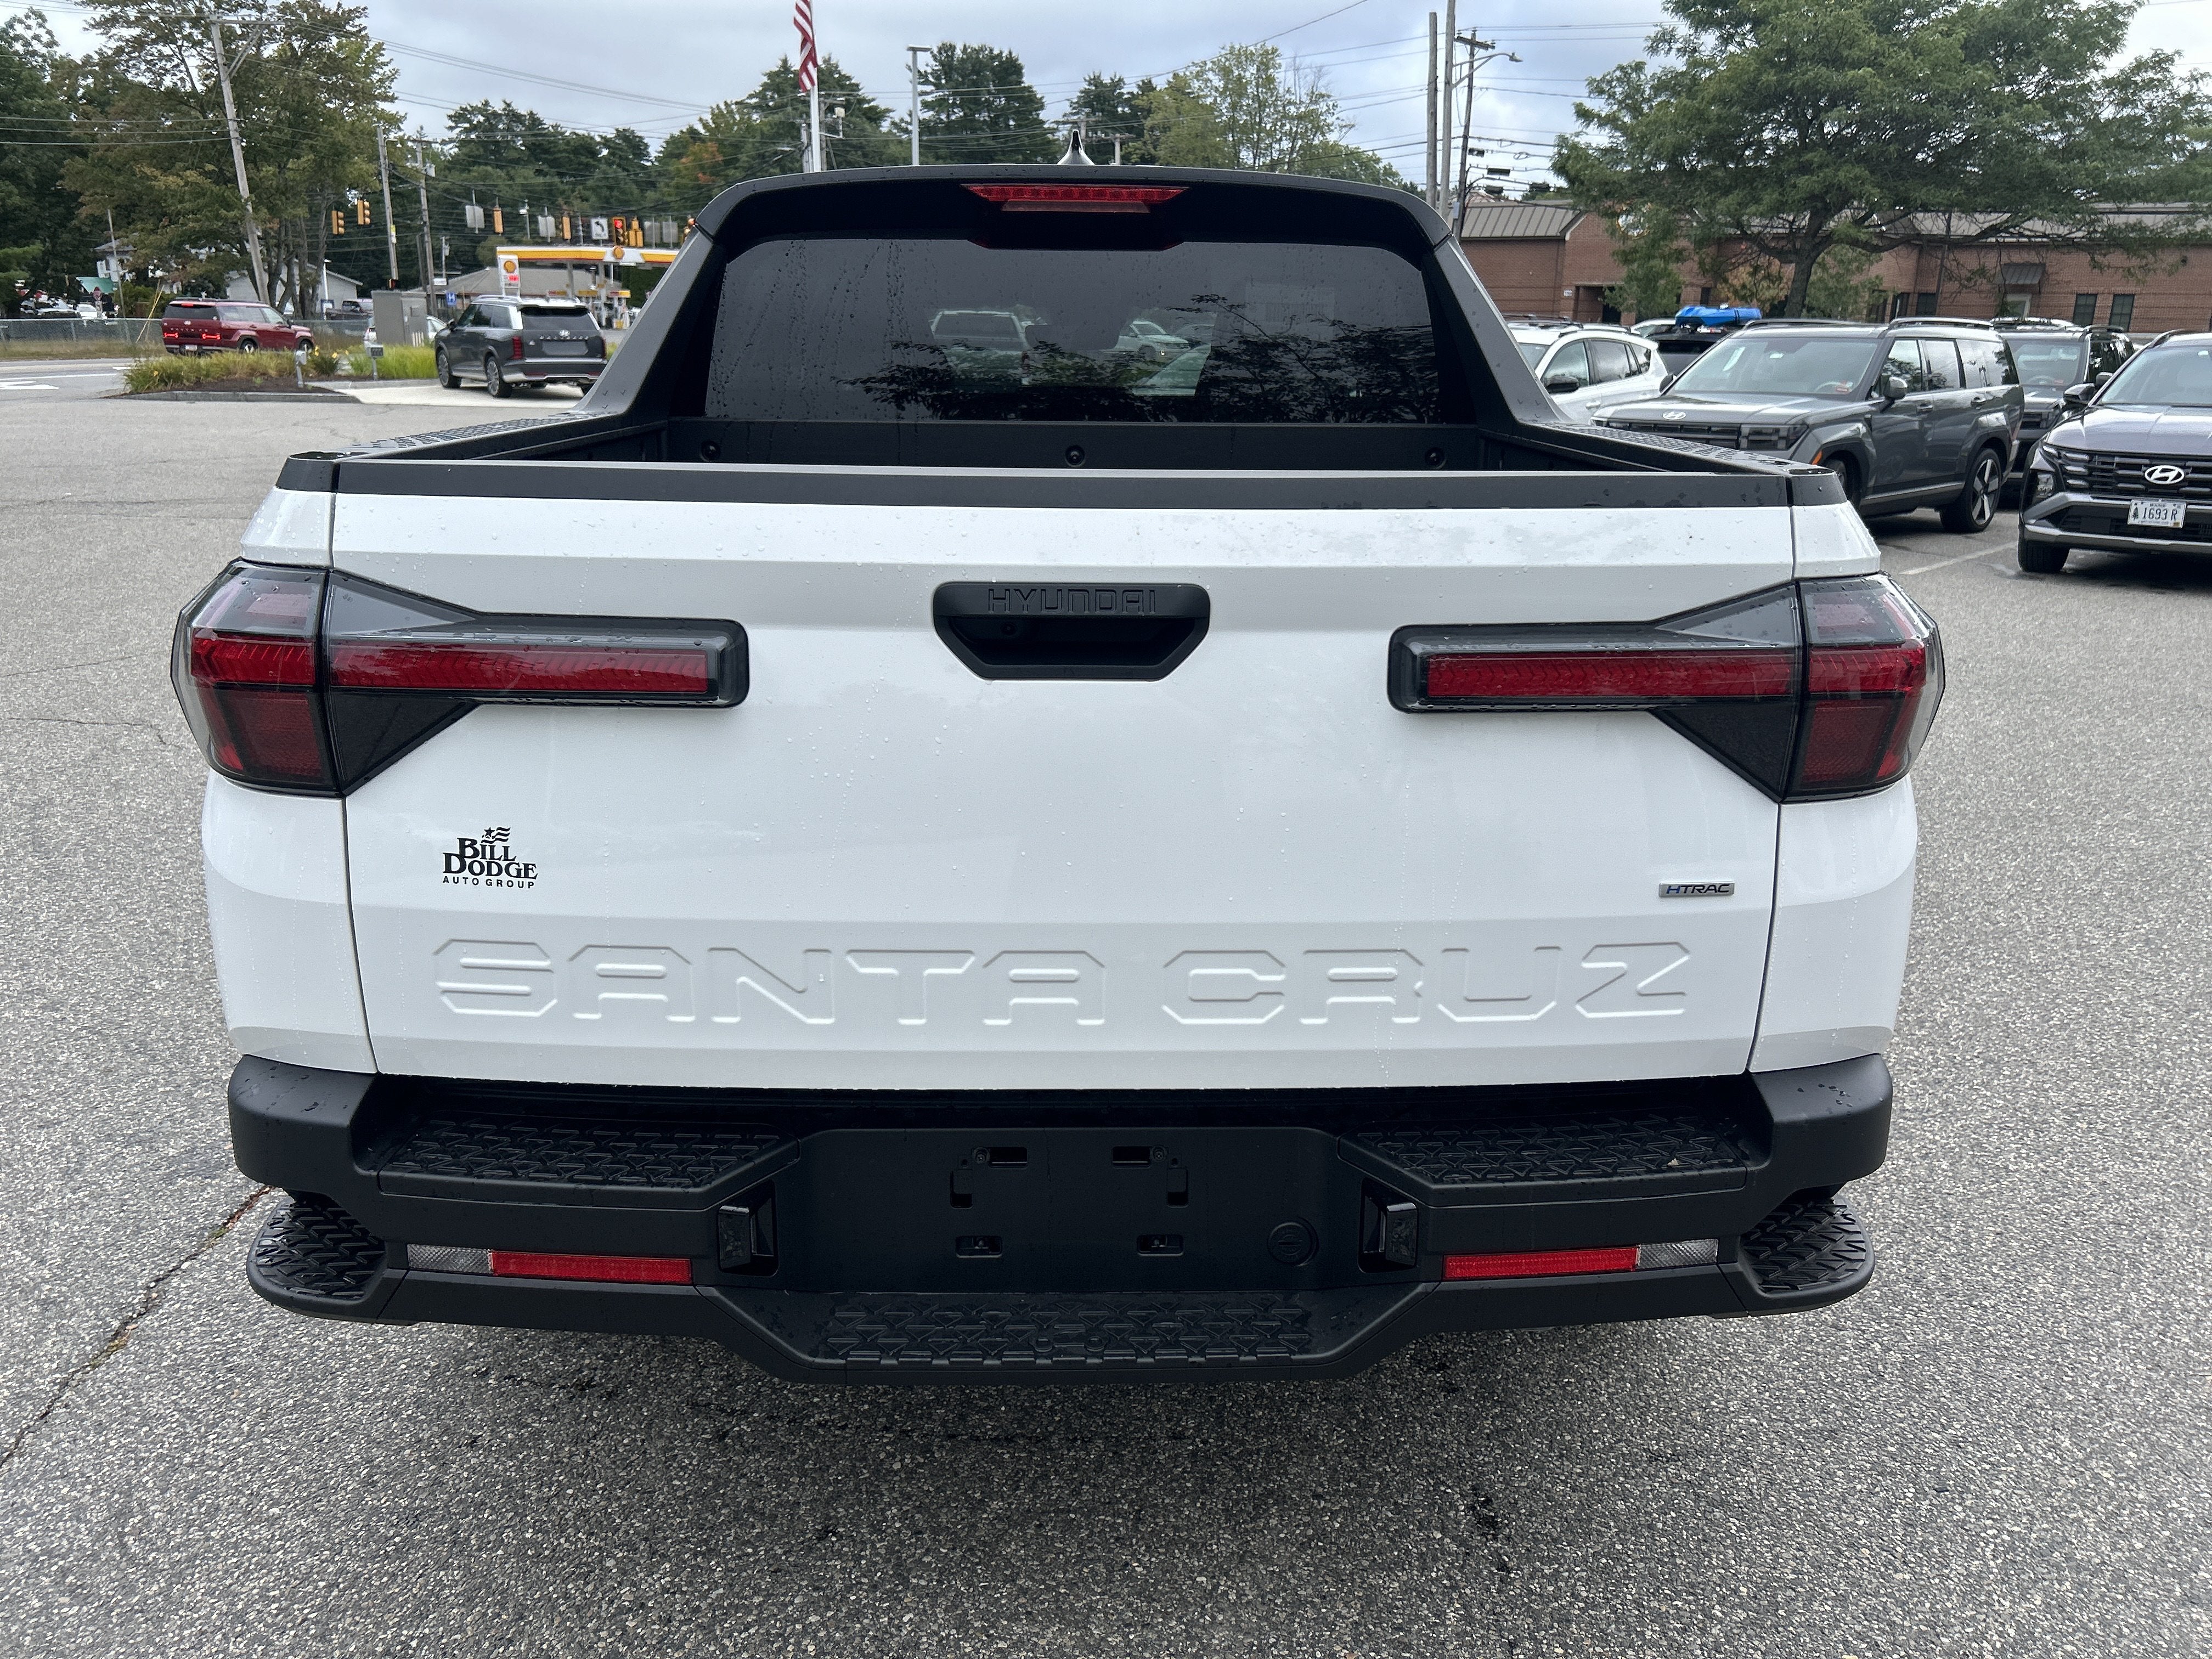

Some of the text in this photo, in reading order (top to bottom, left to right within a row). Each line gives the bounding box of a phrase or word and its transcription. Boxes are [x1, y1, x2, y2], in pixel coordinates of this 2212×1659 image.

[2142, 507, 2177, 521] 1693 R
[988, 589, 1156, 614] HYUNDAI
[457, 837, 517, 862] BILL
[442, 852, 538, 879] DODGE
[443, 876, 534, 889] AUTO GROUP
[1666, 884, 1730, 894] HTRAC
[433, 938, 1691, 1025] SANTA CRUZ
